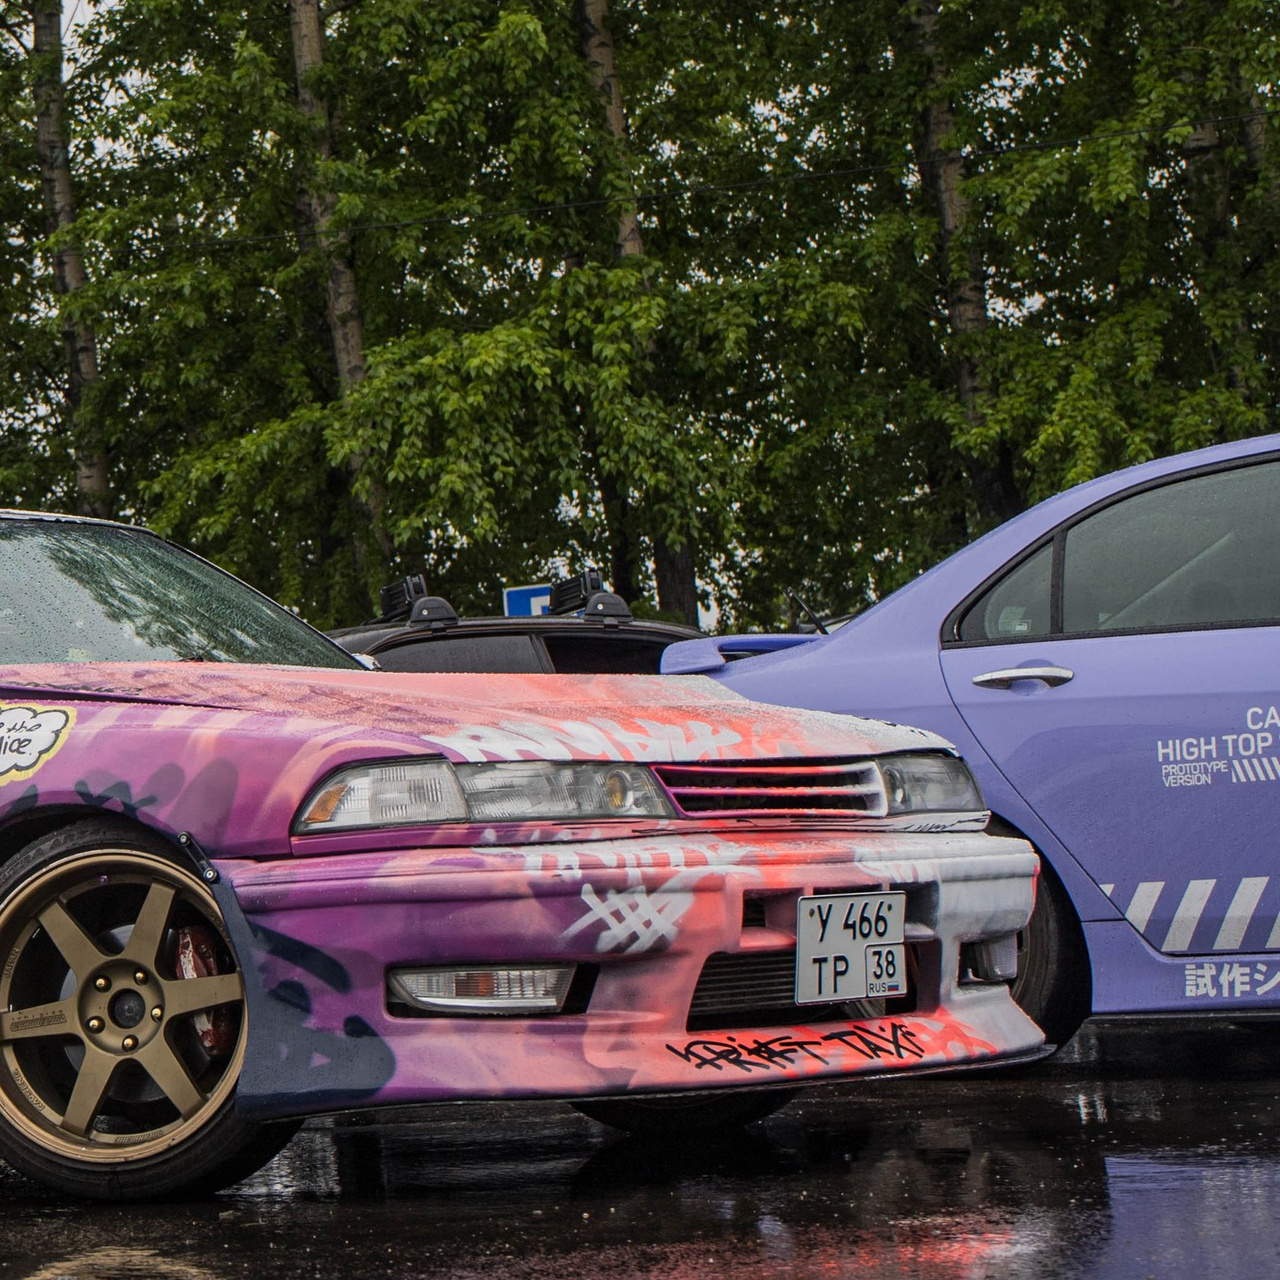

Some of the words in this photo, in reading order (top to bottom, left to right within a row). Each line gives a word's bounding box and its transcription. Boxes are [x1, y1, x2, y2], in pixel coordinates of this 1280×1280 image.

[6, 721, 42, 734] the
[1157, 736, 1217, 762] HIGH
[1222, 732, 1273, 757] TOP
[1162, 760, 1229, 777] PROTOTYPE
[1162, 773, 1212, 788] VERSION
[843, 901, 888, 940] 466
[3, 947, 19, 979] JAPAN
[812, 955, 850, 995] ТР
[872, 950, 896, 980] 38
[869, 982, 887, 993] RUS
